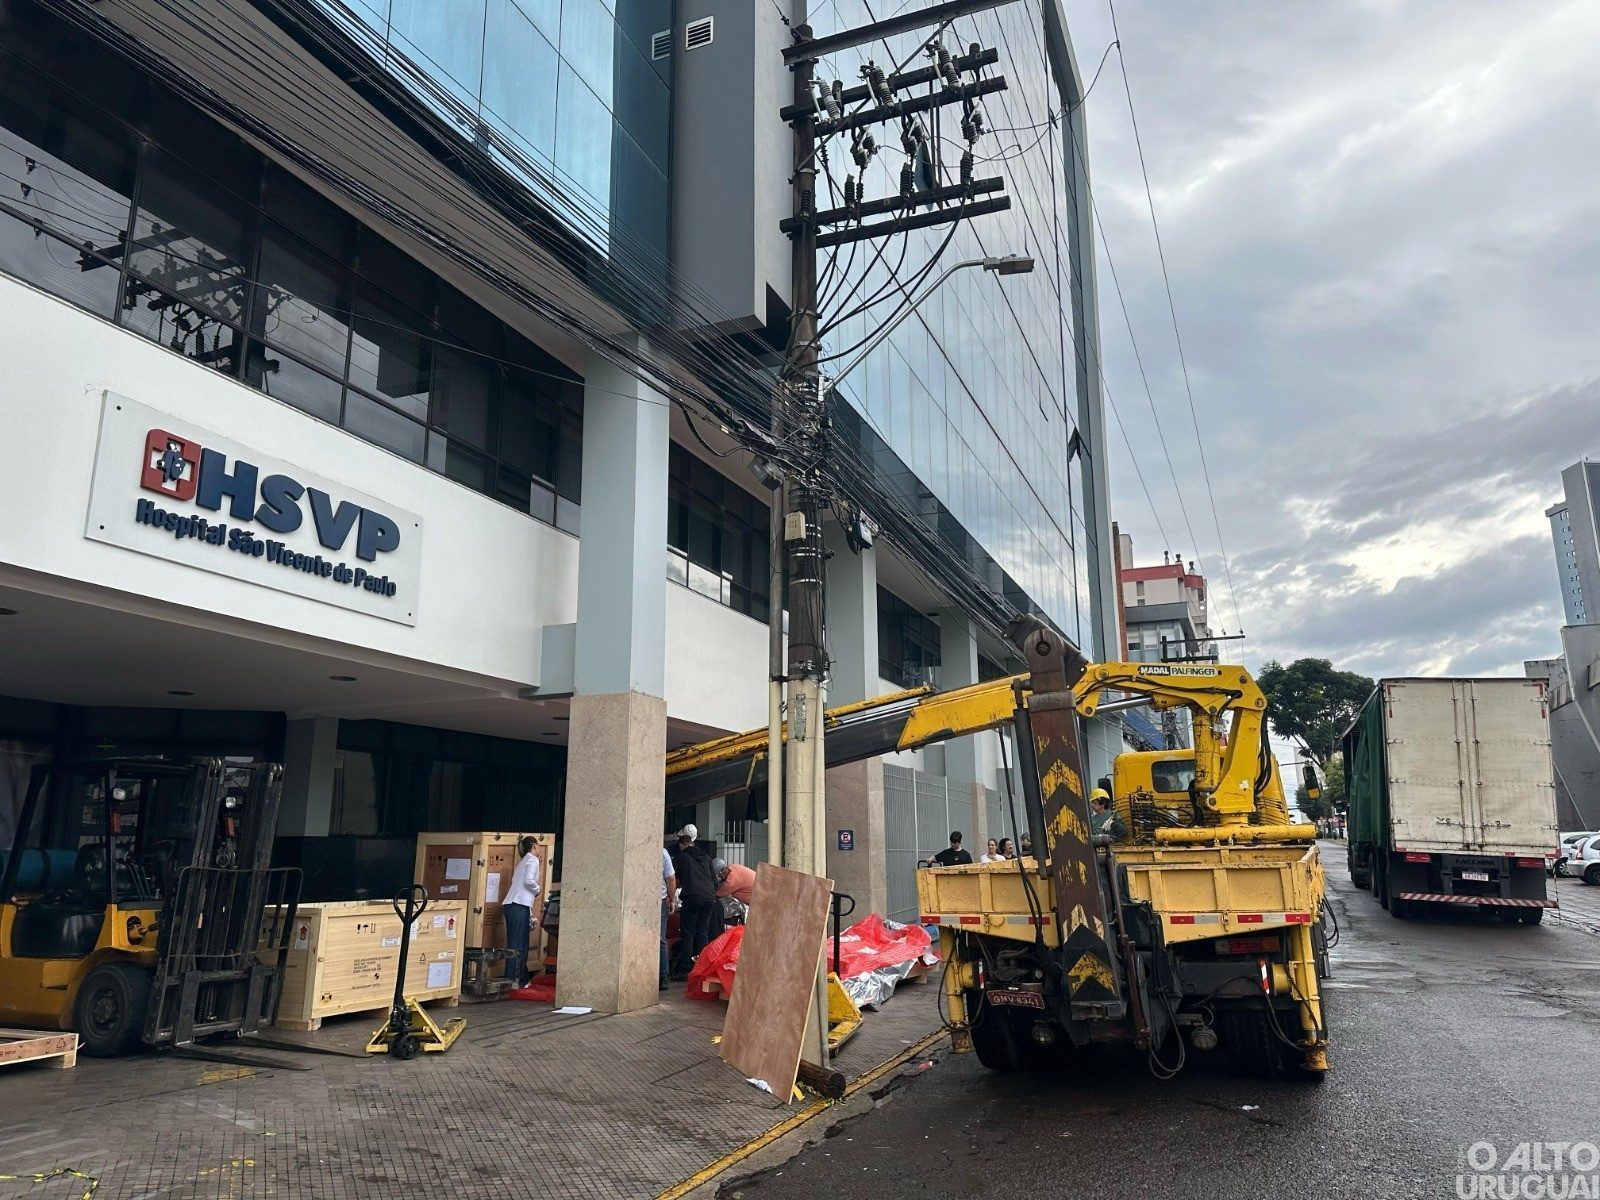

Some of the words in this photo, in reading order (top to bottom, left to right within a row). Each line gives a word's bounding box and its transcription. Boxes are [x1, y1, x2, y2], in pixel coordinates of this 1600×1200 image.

[196, 446, 401, 562] HSVP
[136, 498, 226, 545] Hospital
[228, 528, 264, 557] São
[266, 539, 332, 578] Vicente
[333, 562, 353, 584] de
[354, 567, 397, 597] Paulo
[1140, 666, 1170, 675] MADAL
[1171, 667, 1216, 676] PALFINGER
[1455, 858, 1495, 867] FACCHINI
